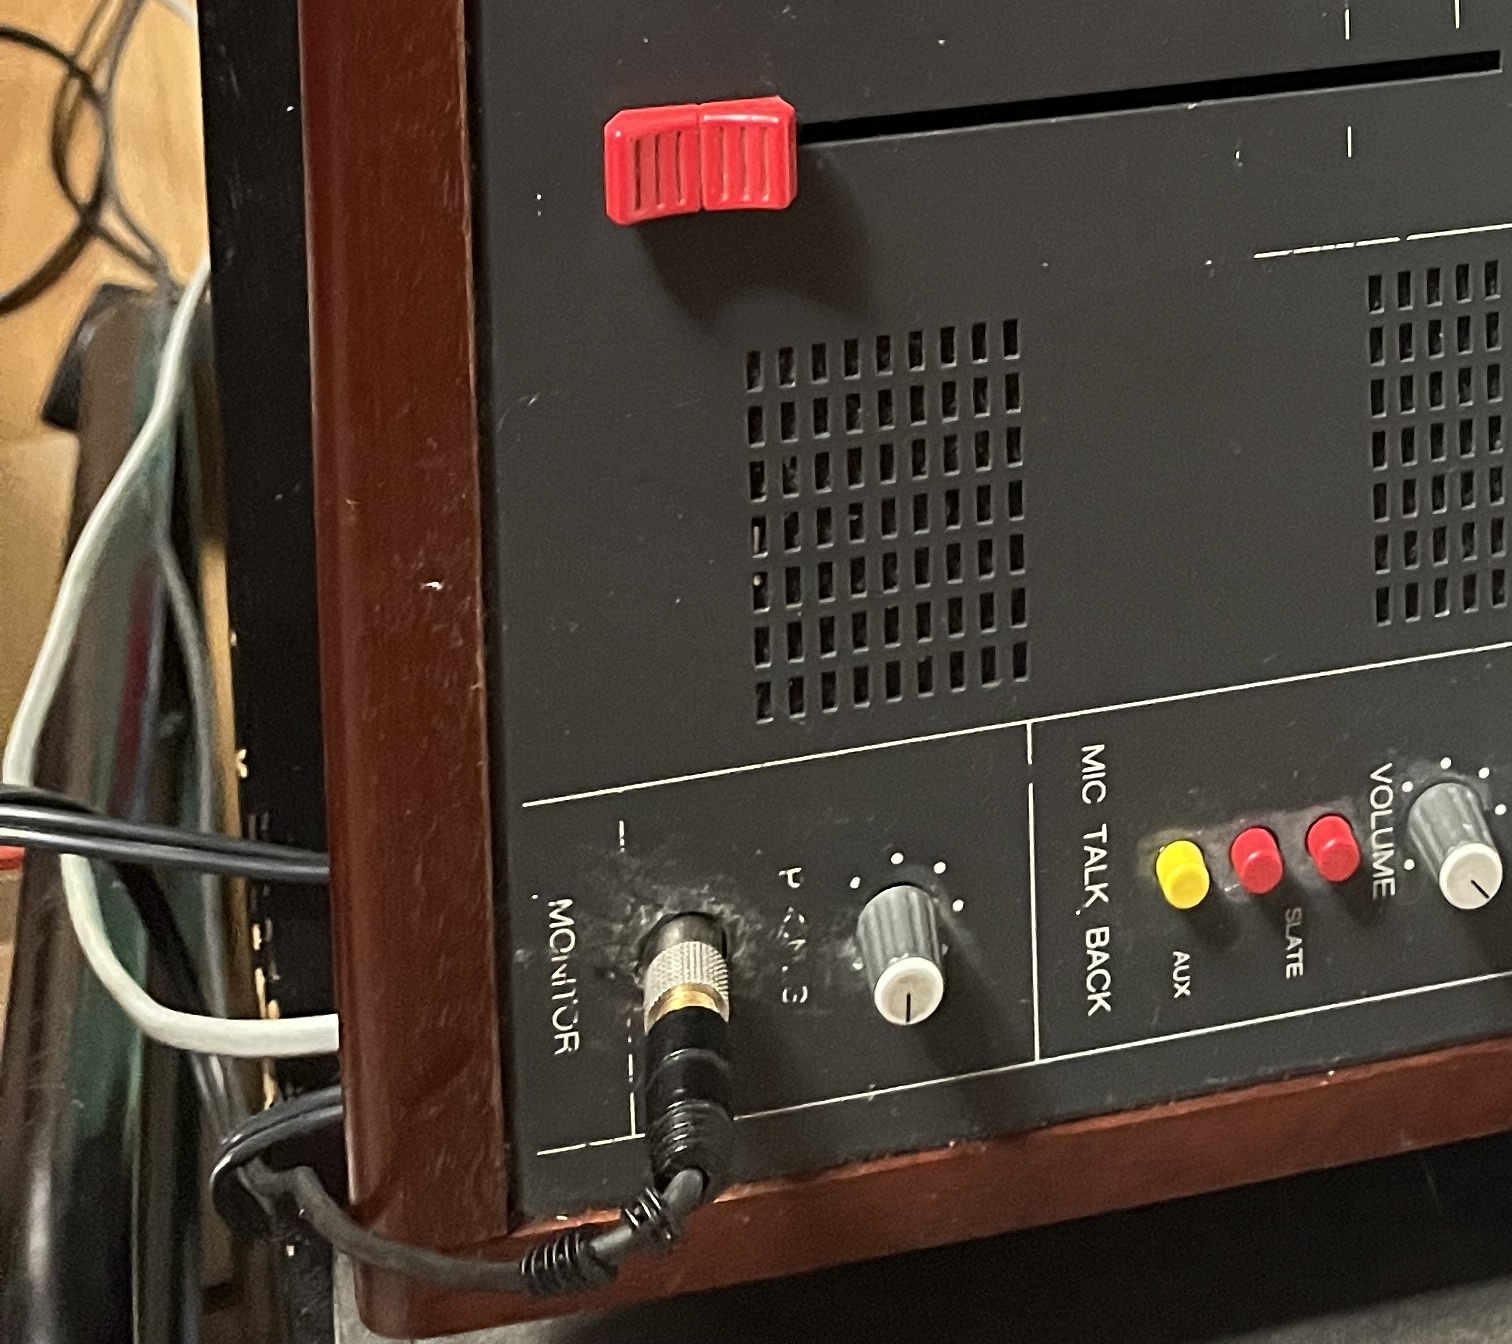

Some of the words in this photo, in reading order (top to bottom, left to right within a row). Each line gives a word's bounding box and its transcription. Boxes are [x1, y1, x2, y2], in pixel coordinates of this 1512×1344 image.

[1082, 745, 1106, 804] MIC
[1083, 824, 1108, 907] TALK
[1370, 763, 1395, 896] VOLUME
[548, 899, 579, 1054] MONITOR
[1086, 927, 1111, 1016] BACK
[1173, 952, 1190, 998] AUX
[1286, 908, 1303, 978] SLATE
